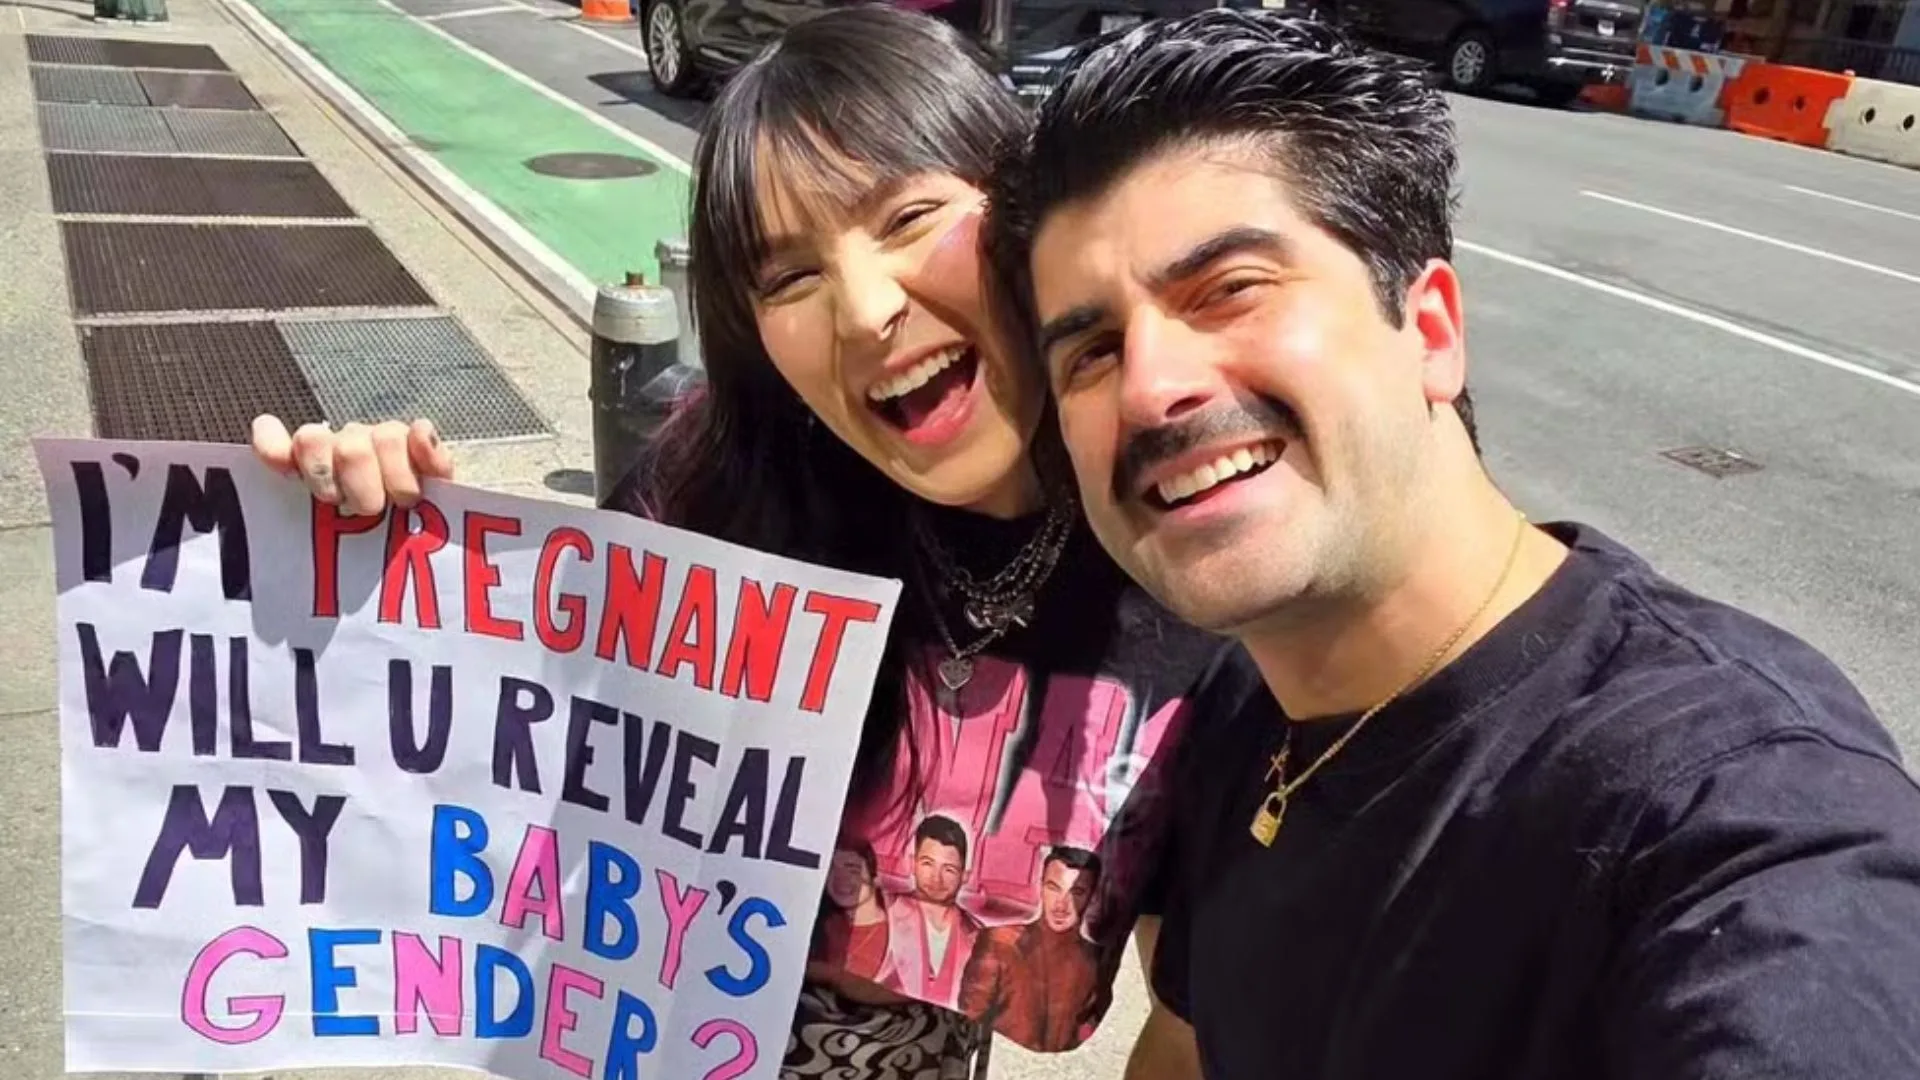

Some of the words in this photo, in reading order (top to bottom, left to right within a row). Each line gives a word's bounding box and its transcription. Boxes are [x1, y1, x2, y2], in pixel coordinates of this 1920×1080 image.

[70, 453, 251, 602] I'M
[311, 492, 882, 715] PREGNANT
[75, 622, 356, 767] WILL
[388, 658, 454, 774] U
[491, 675, 822, 869] REVEAL
[131, 784, 347, 909] MY
[428, 803, 787, 996] BABY'S
